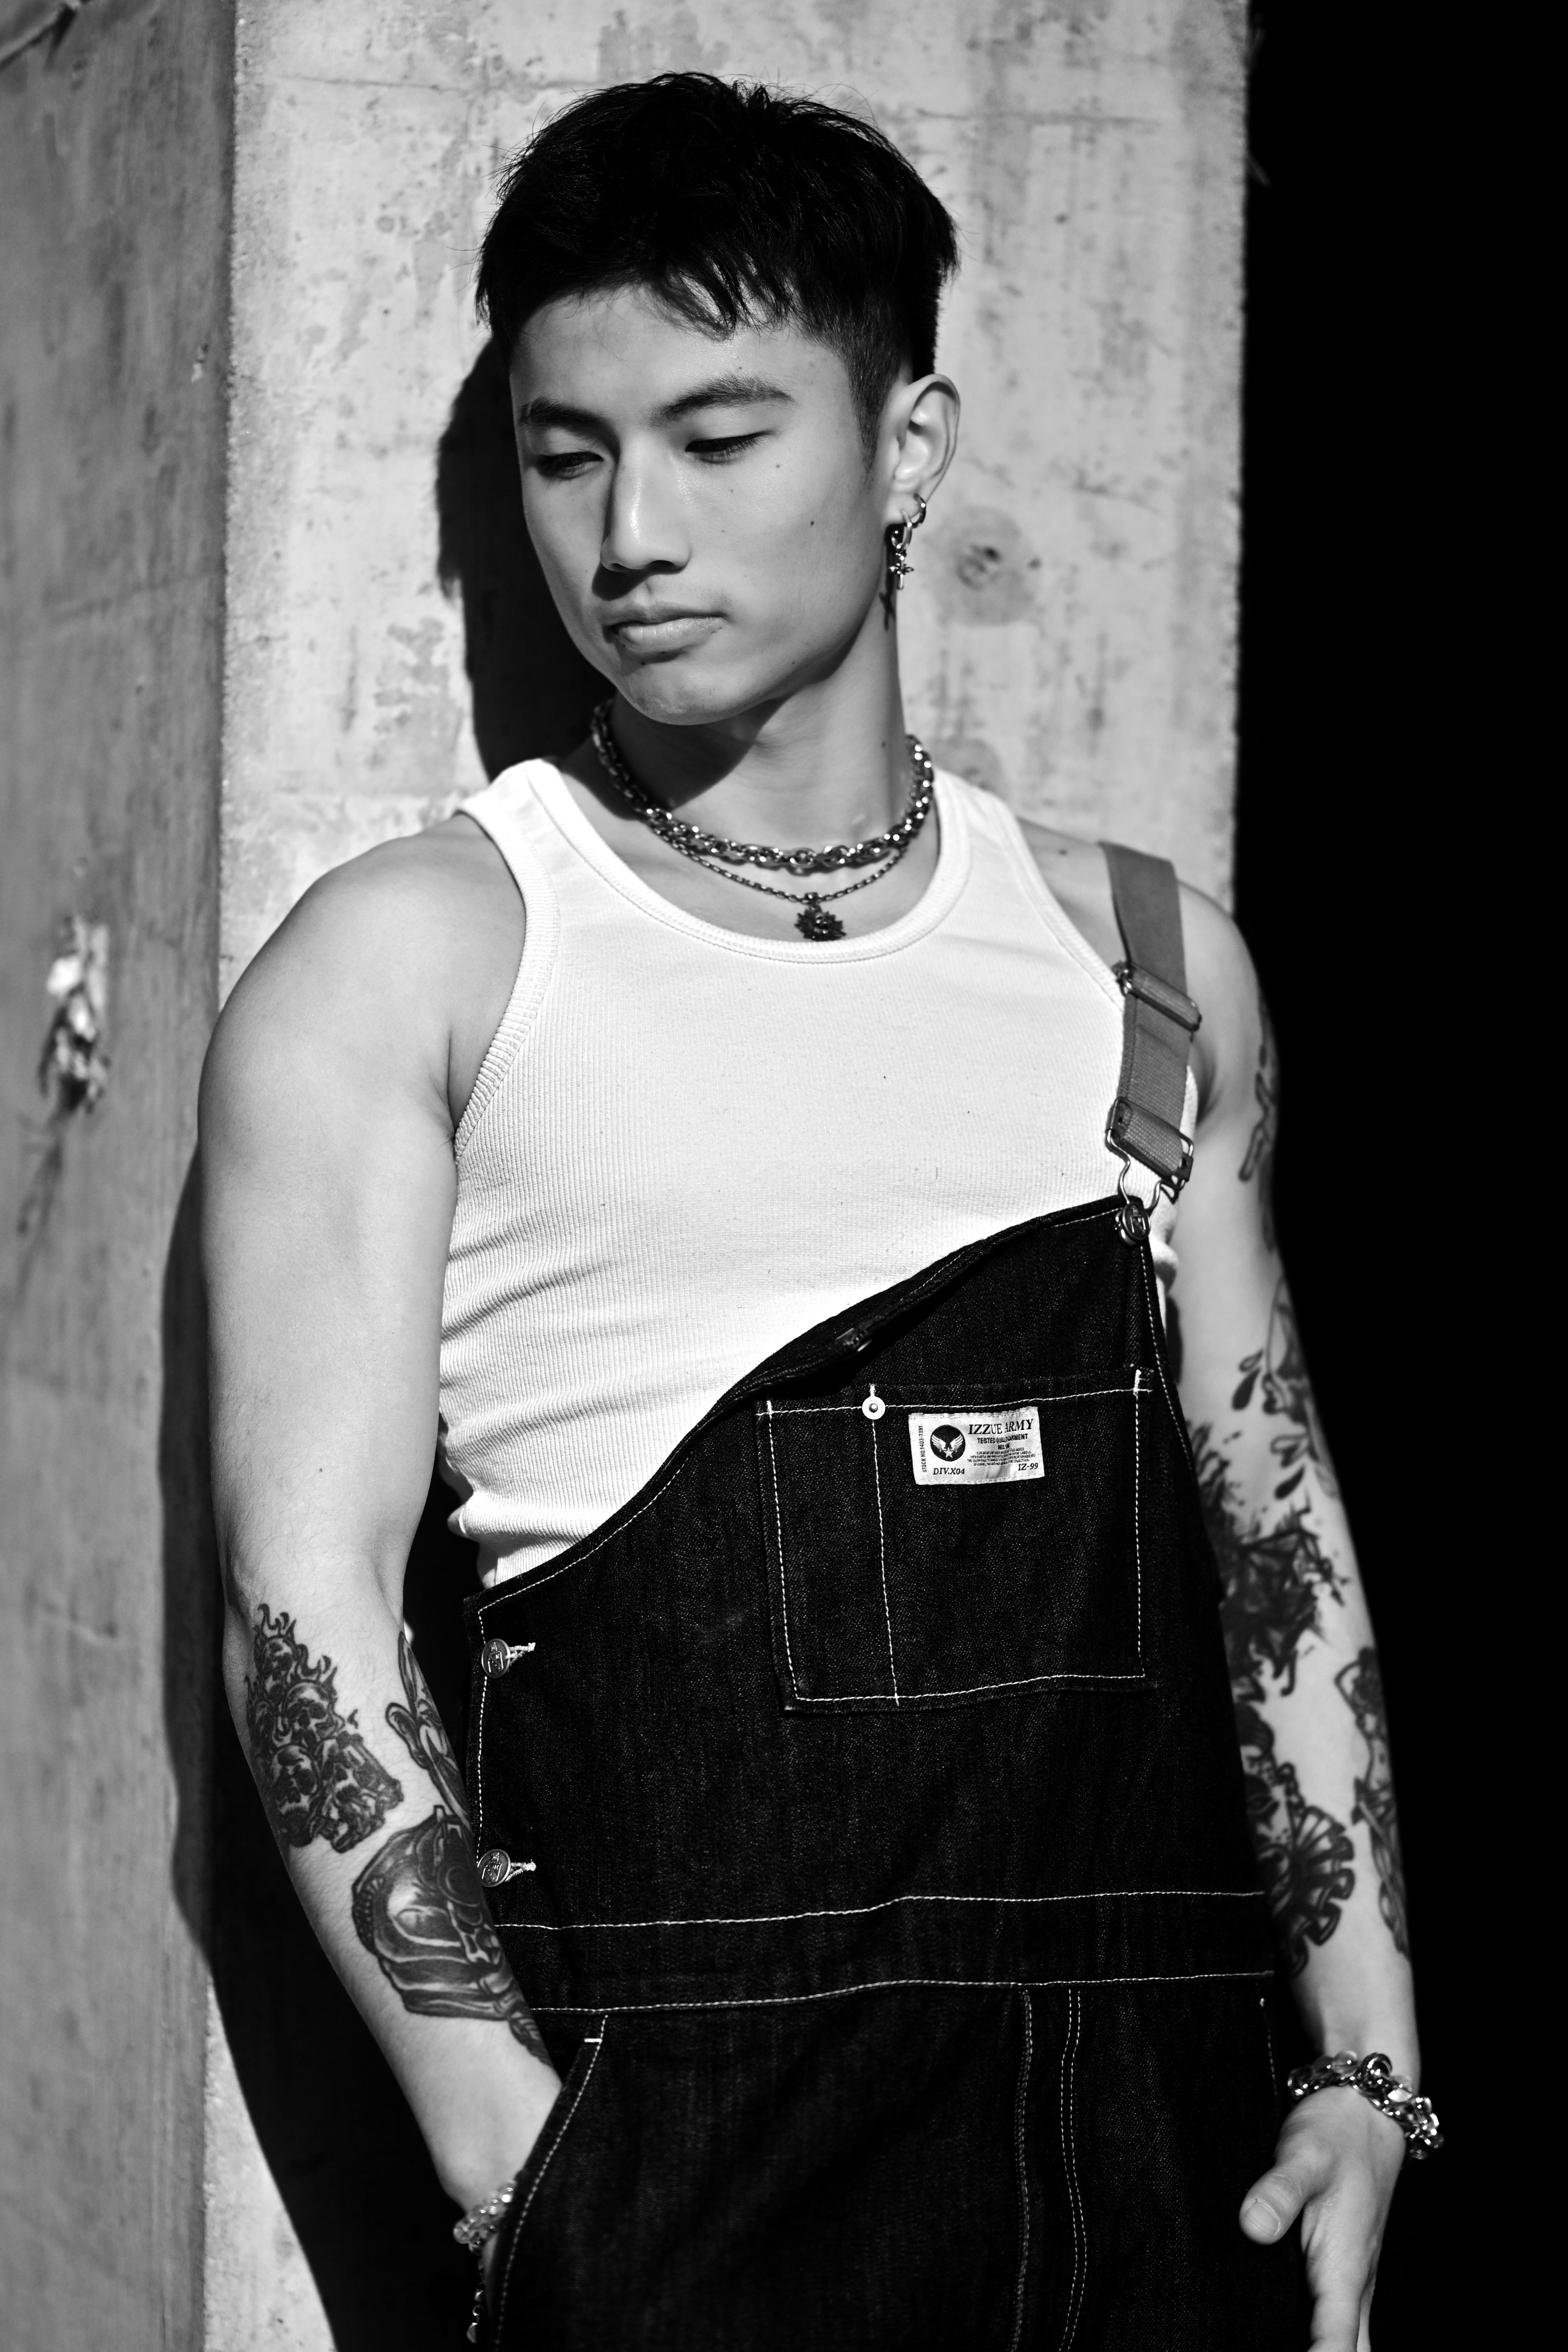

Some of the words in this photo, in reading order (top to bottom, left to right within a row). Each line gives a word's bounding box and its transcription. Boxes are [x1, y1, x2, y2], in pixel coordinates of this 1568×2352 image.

[968, 1423, 1003, 1435] IZZUE
[1004, 1419, 1034, 1433] ARMY
[1018, 1463, 1038, 1471] IZ-99
